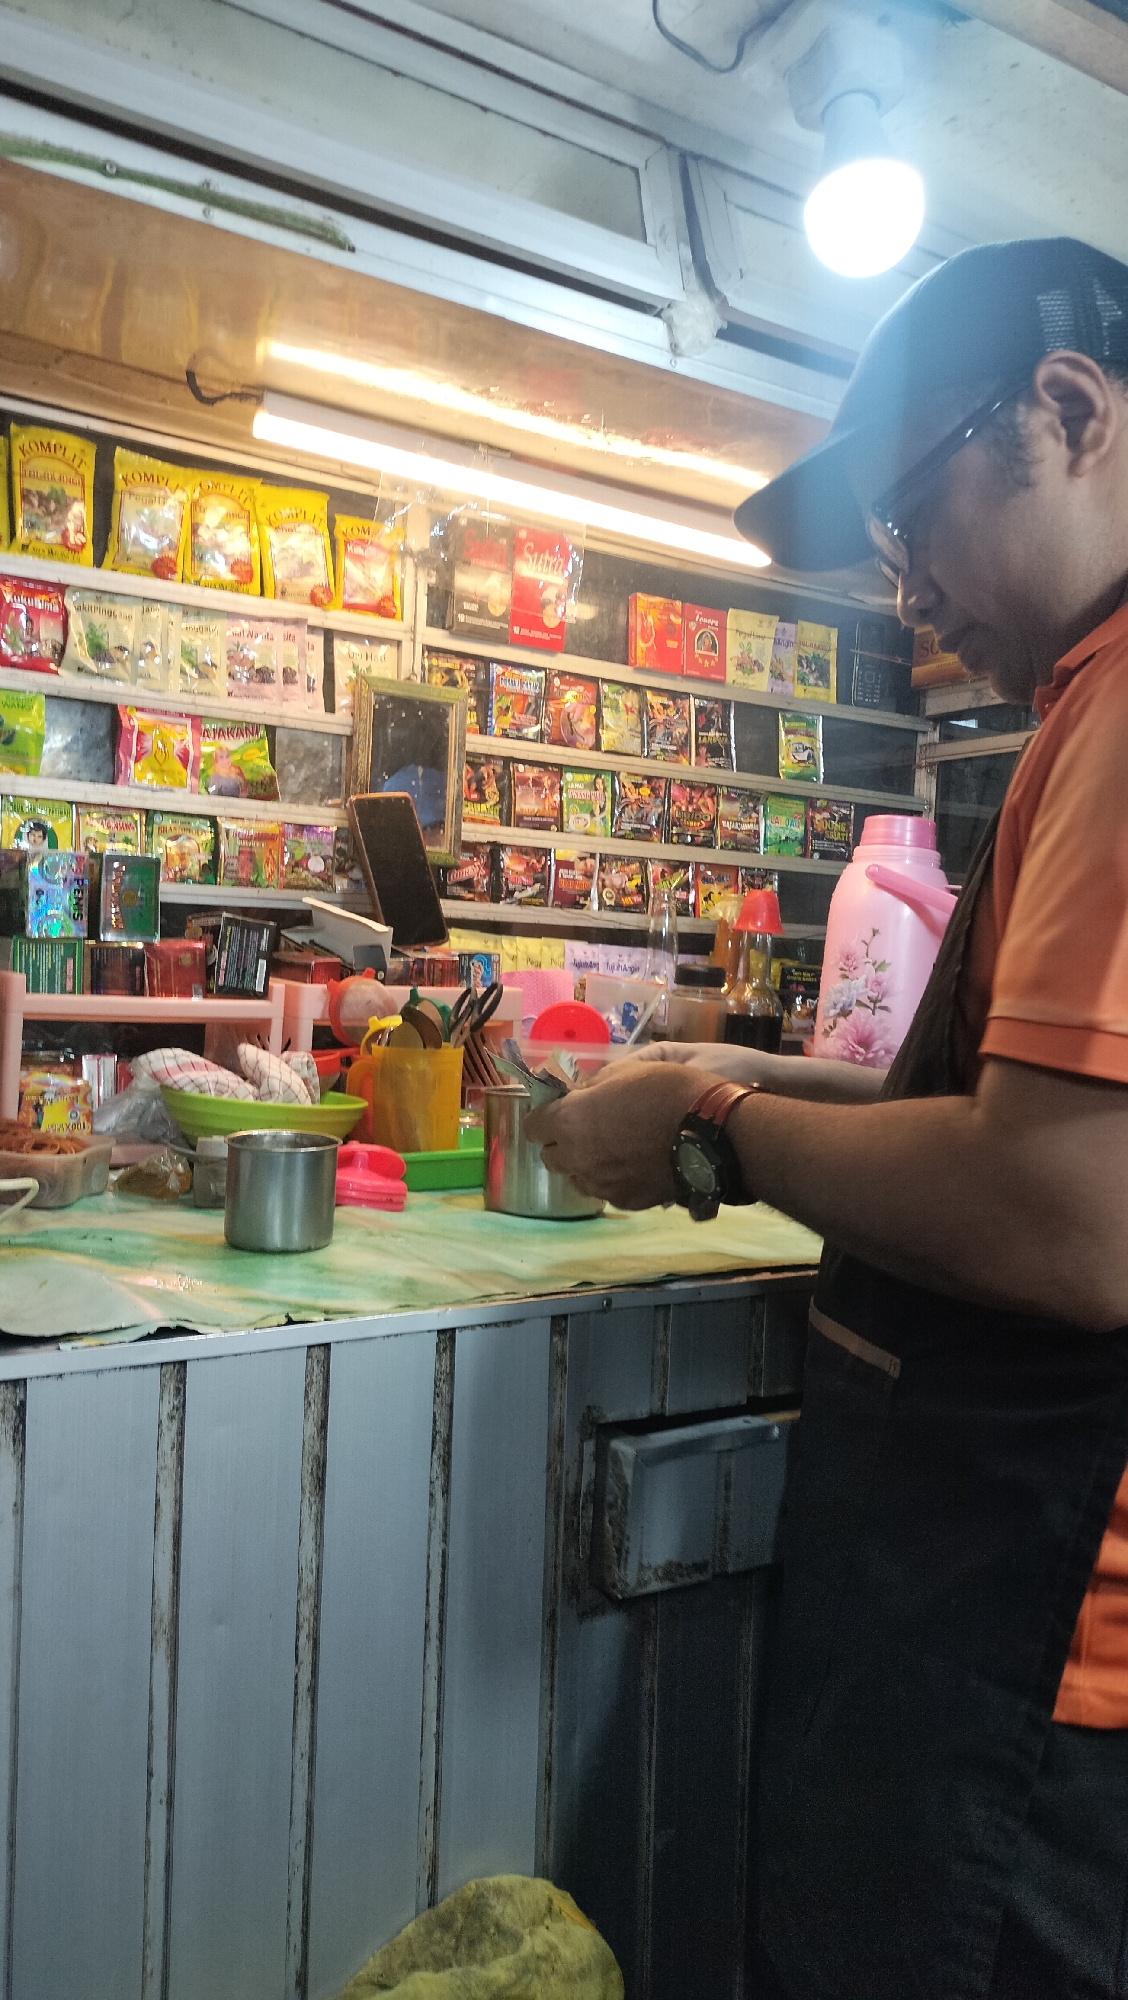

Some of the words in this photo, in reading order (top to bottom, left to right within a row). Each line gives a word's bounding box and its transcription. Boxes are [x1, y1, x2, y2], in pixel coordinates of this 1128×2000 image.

[18, 440, 88, 470] KOMPLIT
[265, 507, 327, 528] KOMPLIT
[462, 528, 508, 568] Sutra
[522, 541, 566, 577] Sutra
[201, 724, 260, 741] AJAKANI
